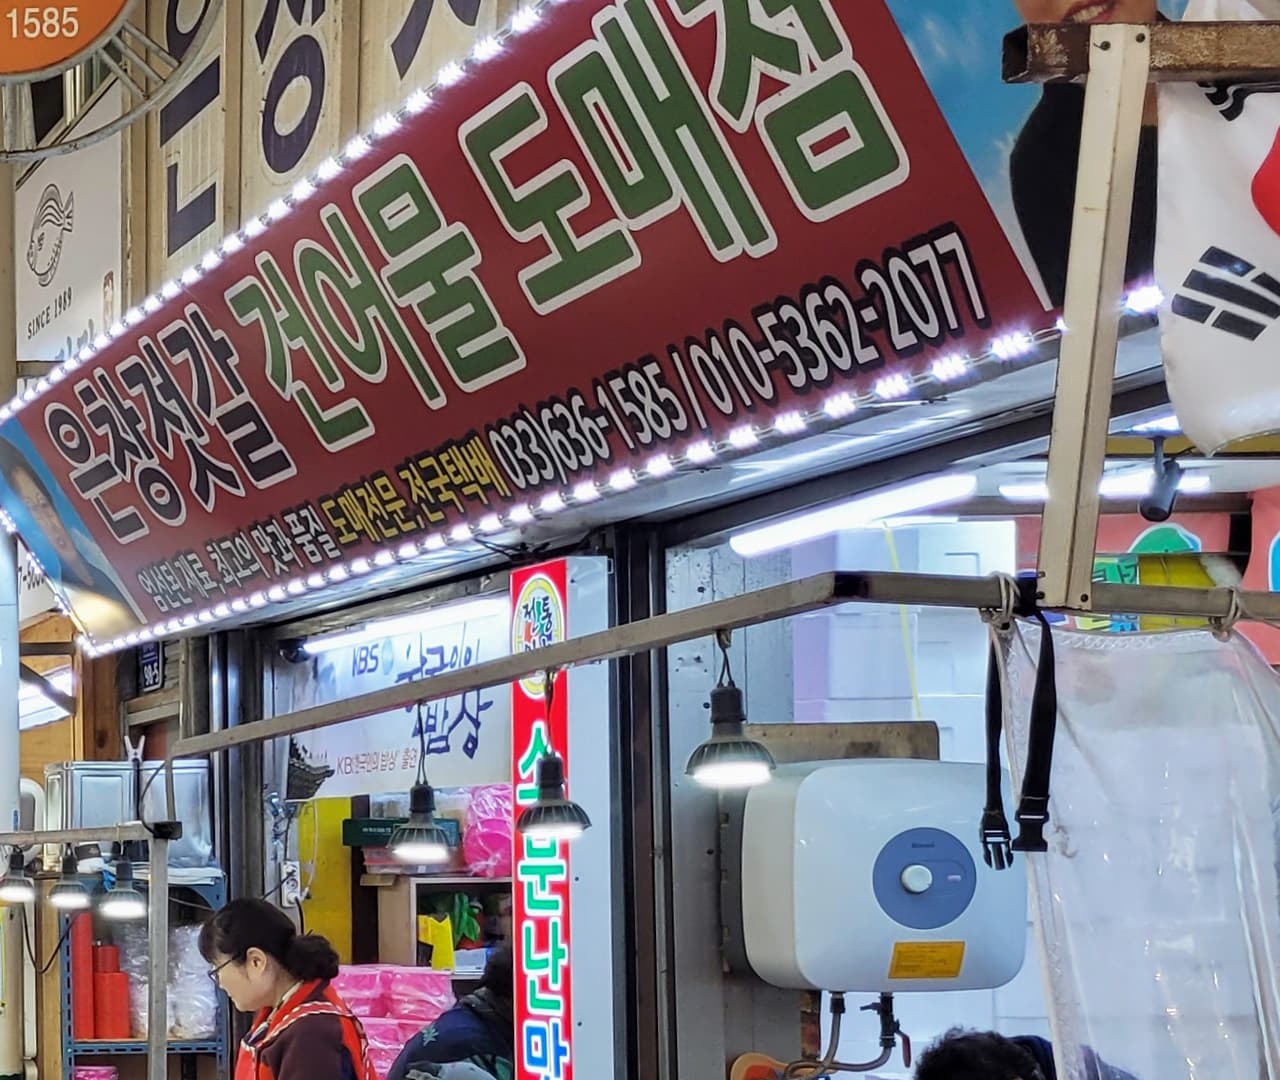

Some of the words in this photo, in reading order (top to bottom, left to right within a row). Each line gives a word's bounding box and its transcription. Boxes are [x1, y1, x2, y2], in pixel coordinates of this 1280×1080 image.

[6, 6, 79, 39] 1585
[27, 305, 52, 341] SINCE
[44, 302, 297, 545] 은창젓갈
[206, 531, 271, 588] 최고의
[251, 518, 305, 580] 맛과
[283, 505, 341, 565] 품질
[488, 360, 689, 491] 033)636-1585
[690, 231, 987, 417] 010-5362-2077
[352, 643, 380, 678] KBS
